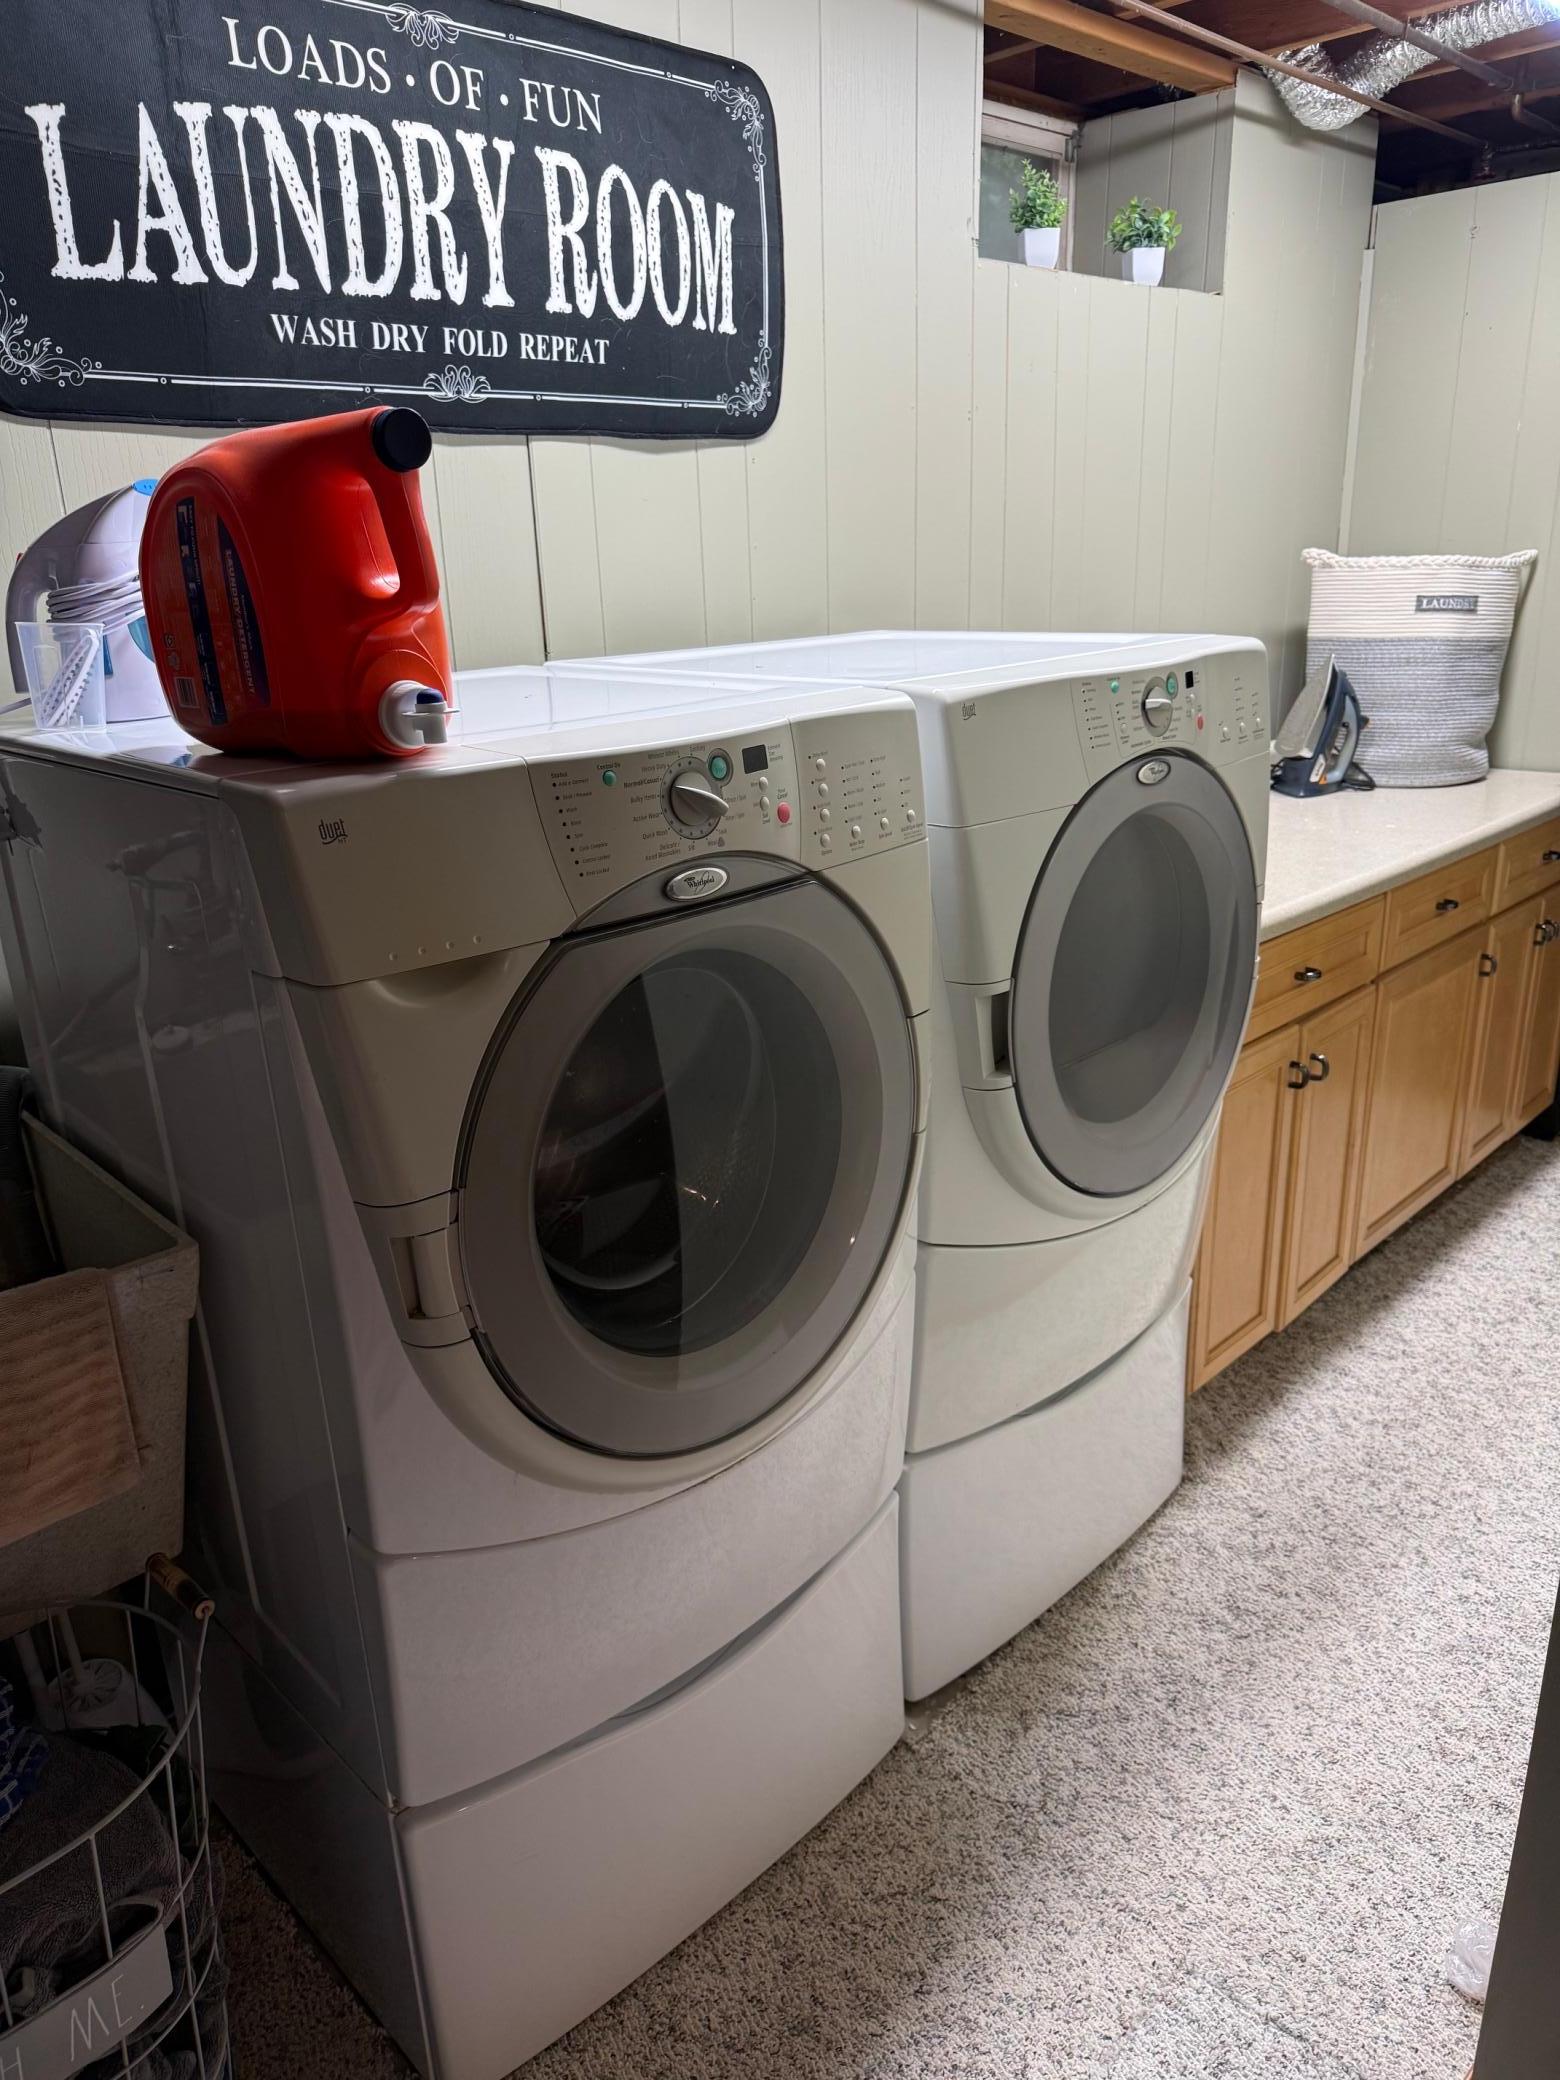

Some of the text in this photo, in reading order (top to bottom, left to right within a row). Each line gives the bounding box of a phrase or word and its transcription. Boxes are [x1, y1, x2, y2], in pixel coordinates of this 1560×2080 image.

[222, 16, 603, 135] LOADS OF FUN
[24, 101, 738, 336] LAUNDRY ROOM
[270, 313, 611, 367] WASH DRY FOLD REPEAT
[225, 549, 242, 613] LAUNDRY
[319, 818, 348, 845] duet
